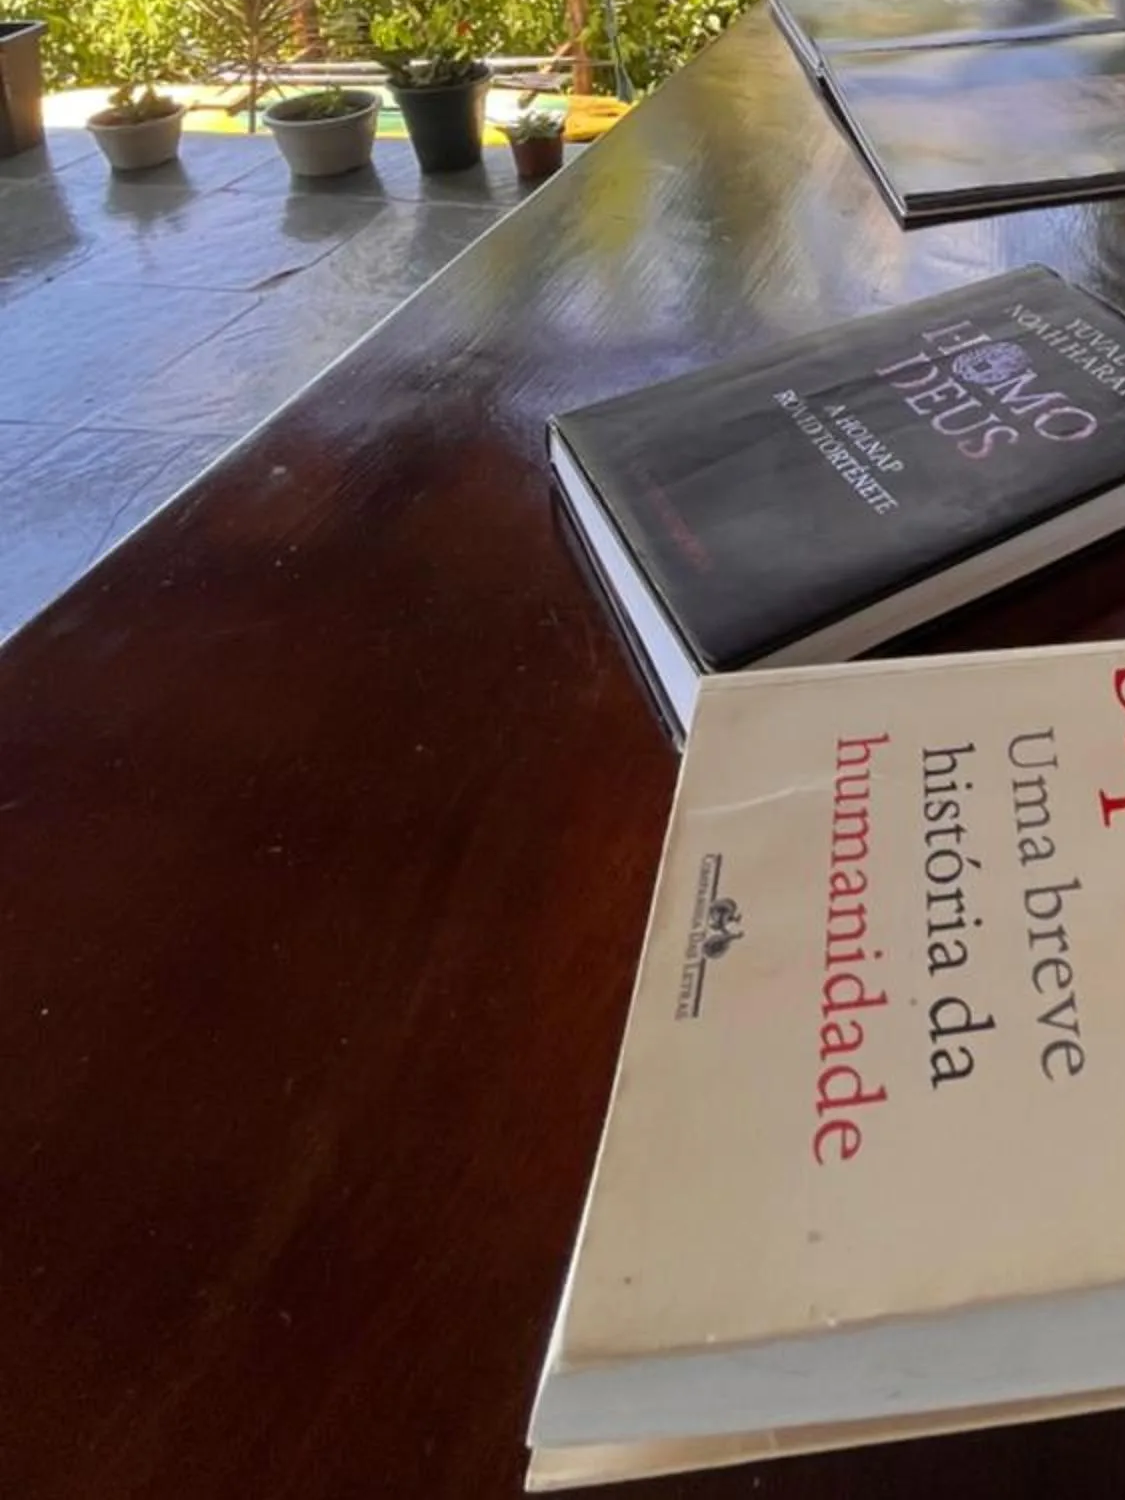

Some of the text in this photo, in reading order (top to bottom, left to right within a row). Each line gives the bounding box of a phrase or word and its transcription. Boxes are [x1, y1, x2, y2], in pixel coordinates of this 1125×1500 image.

[921, 320, 1098, 442] HOMO
[1004, 303, 1066, 347] NOAH
[823, 404, 905, 472] A HOLNAP
[875, 352, 1020, 460] DEUS
[813, 732, 891, 1167] humanidade
[922, 742, 997, 1091] história da
[1007, 726, 1086, 1082] Uma breve
